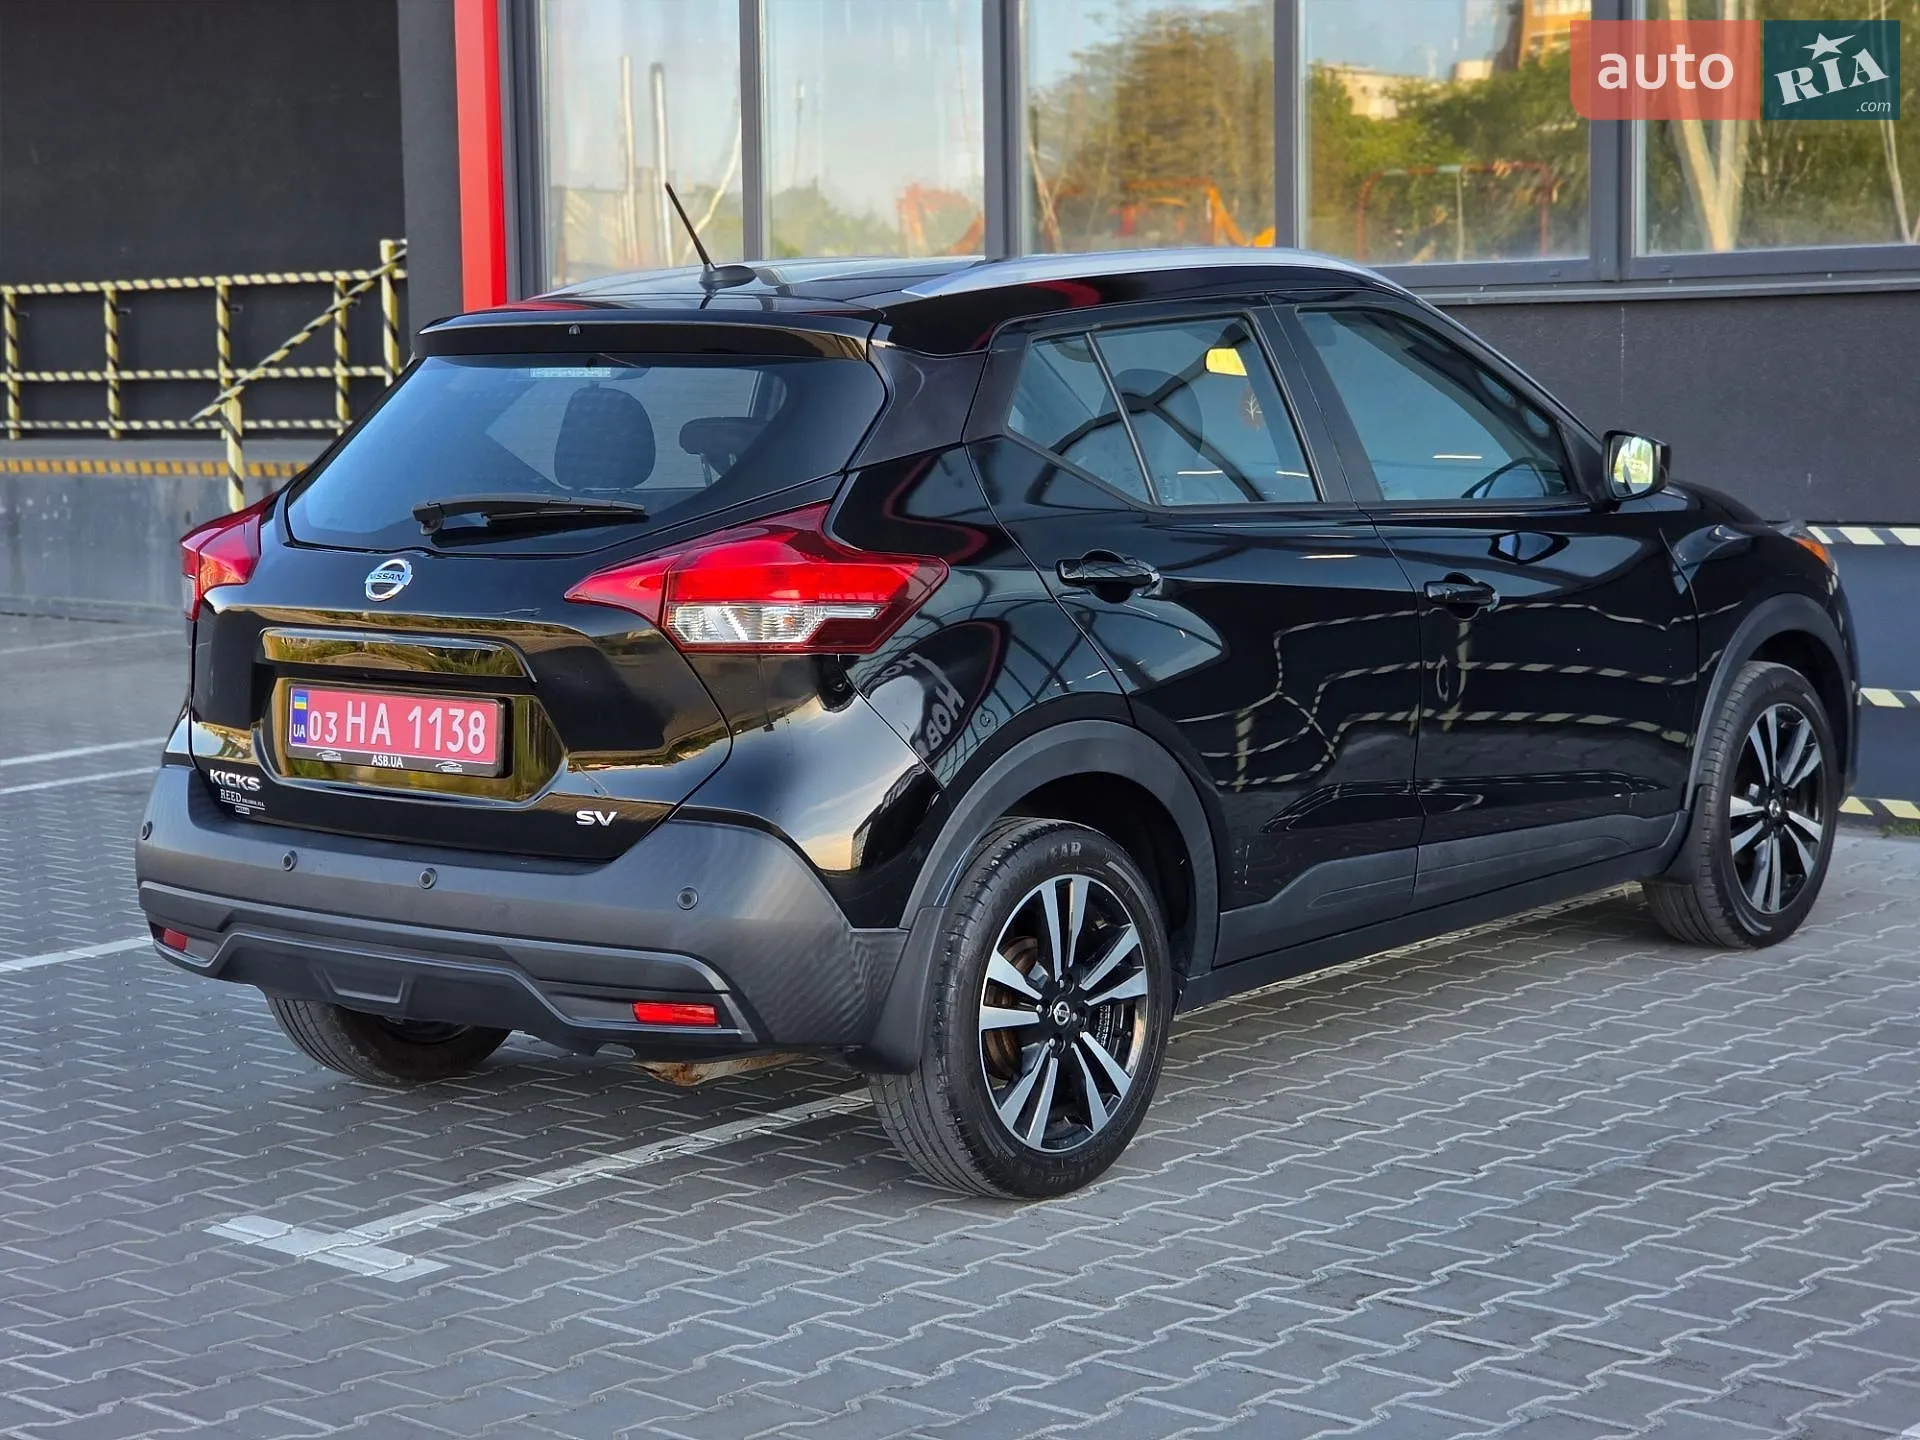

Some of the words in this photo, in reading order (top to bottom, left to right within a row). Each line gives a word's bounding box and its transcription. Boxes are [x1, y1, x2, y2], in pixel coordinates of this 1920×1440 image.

[293, 724, 306, 739] UA
[309, 710, 338, 744] 03
[346, 700, 392, 746] HA
[408, 705, 486, 755] 1138
[371, 754, 404, 769] ASB.UA
[209, 768, 261, 792] KICKS
[220, 788, 242, 803] REED
[575, 810, 618, 827] SV
